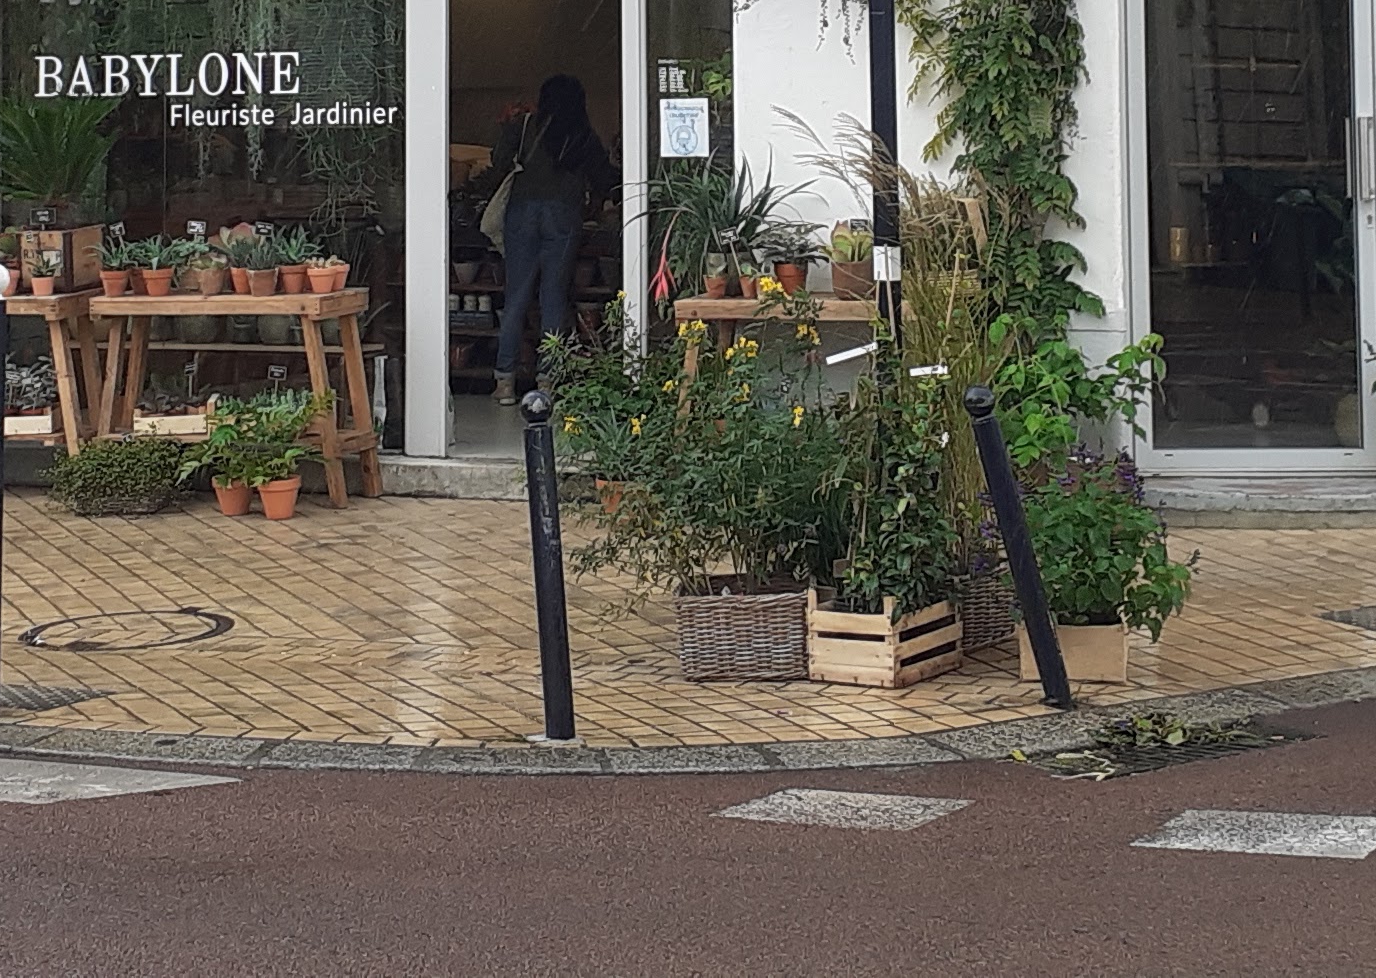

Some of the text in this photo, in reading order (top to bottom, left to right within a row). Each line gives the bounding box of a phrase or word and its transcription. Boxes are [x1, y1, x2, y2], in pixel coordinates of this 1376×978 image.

[33, 51, 301, 98] BABYLONE
[170, 101, 398, 128] Fleuriste Jardinier
